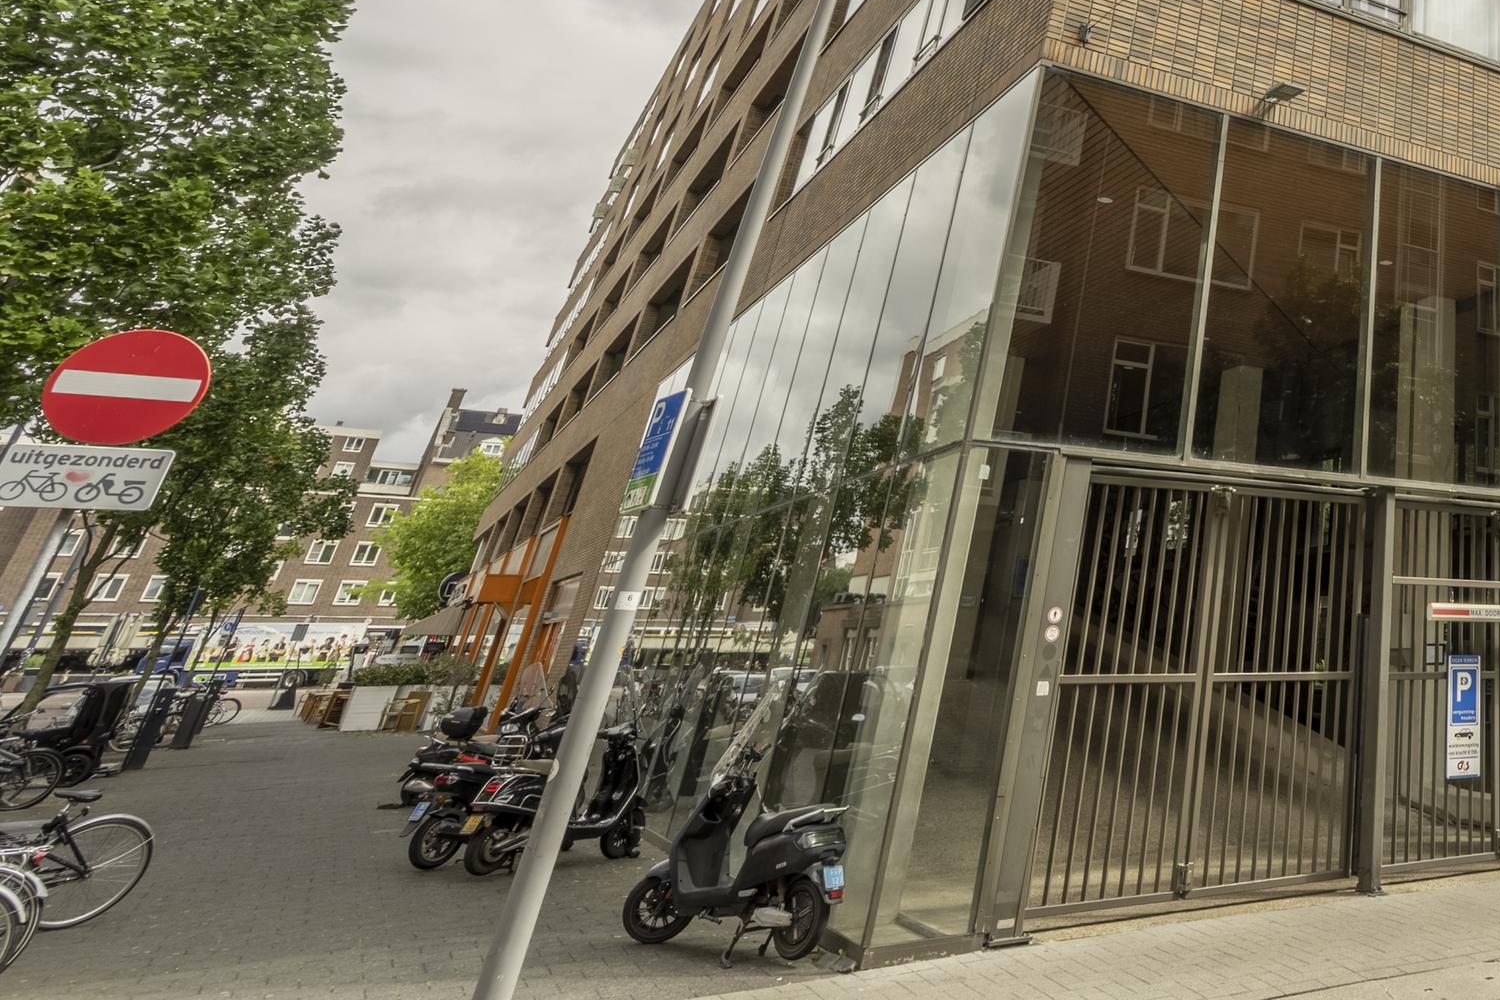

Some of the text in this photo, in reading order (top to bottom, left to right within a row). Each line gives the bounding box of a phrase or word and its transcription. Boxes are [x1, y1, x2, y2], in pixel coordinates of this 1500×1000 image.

[647, 401, 666, 437] P
[10, 450, 166, 469] uitgezonderd
[1457, 672, 1472, 702] P
